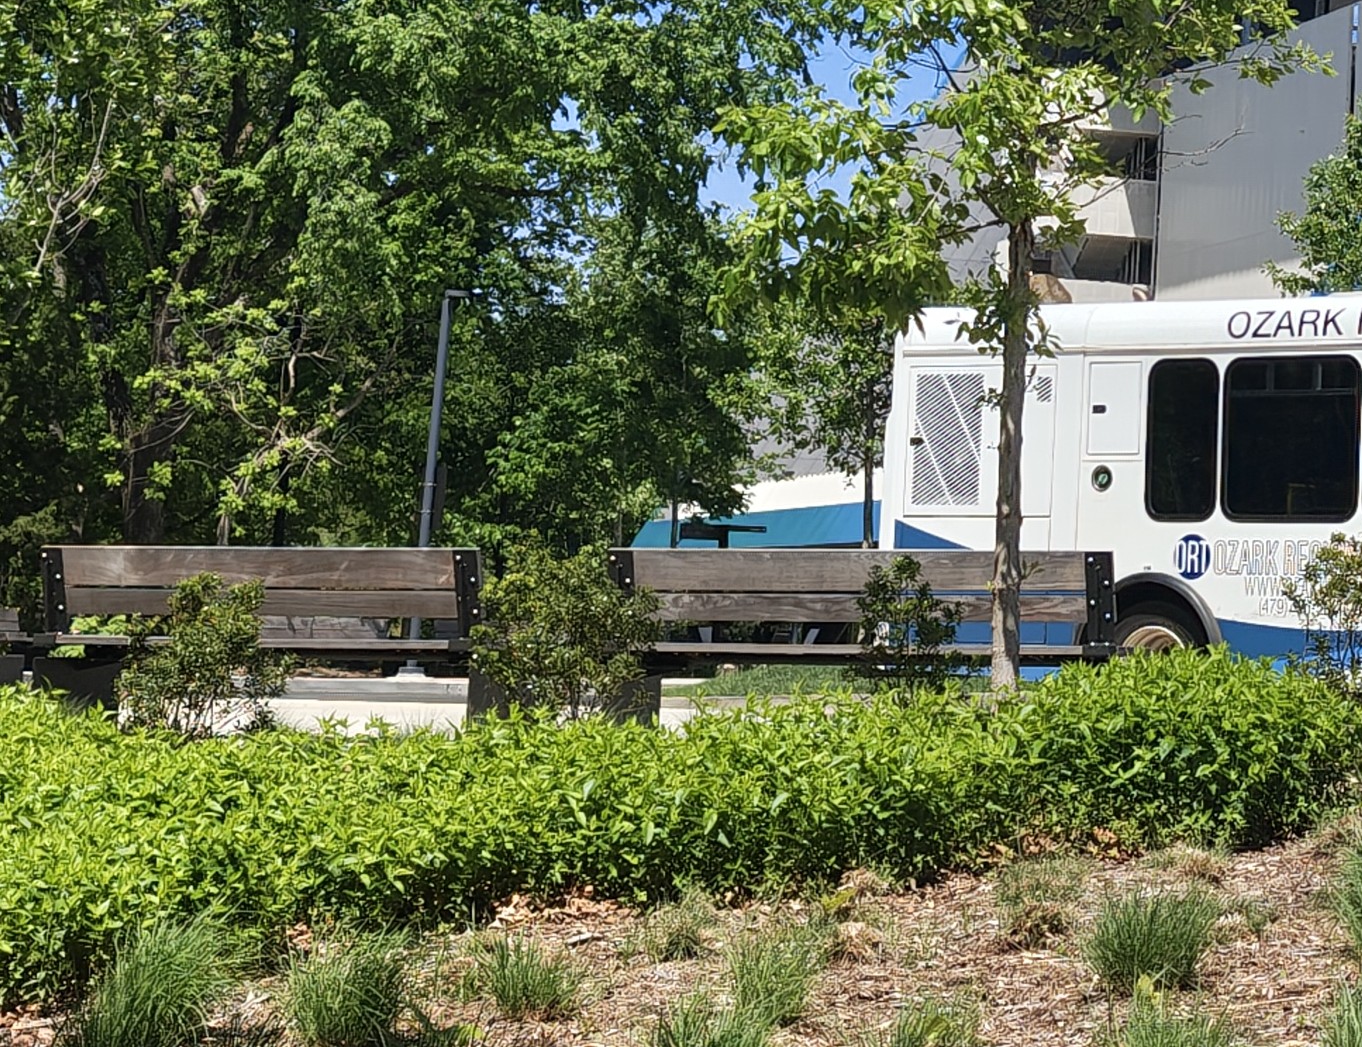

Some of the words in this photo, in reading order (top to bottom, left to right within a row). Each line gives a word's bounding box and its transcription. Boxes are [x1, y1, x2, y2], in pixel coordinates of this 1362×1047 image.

[1227, 307, 1345, 339] OZARK
[1176, 540, 1209, 574] ORT
[1213, 539, 1279, 576] OZARK
